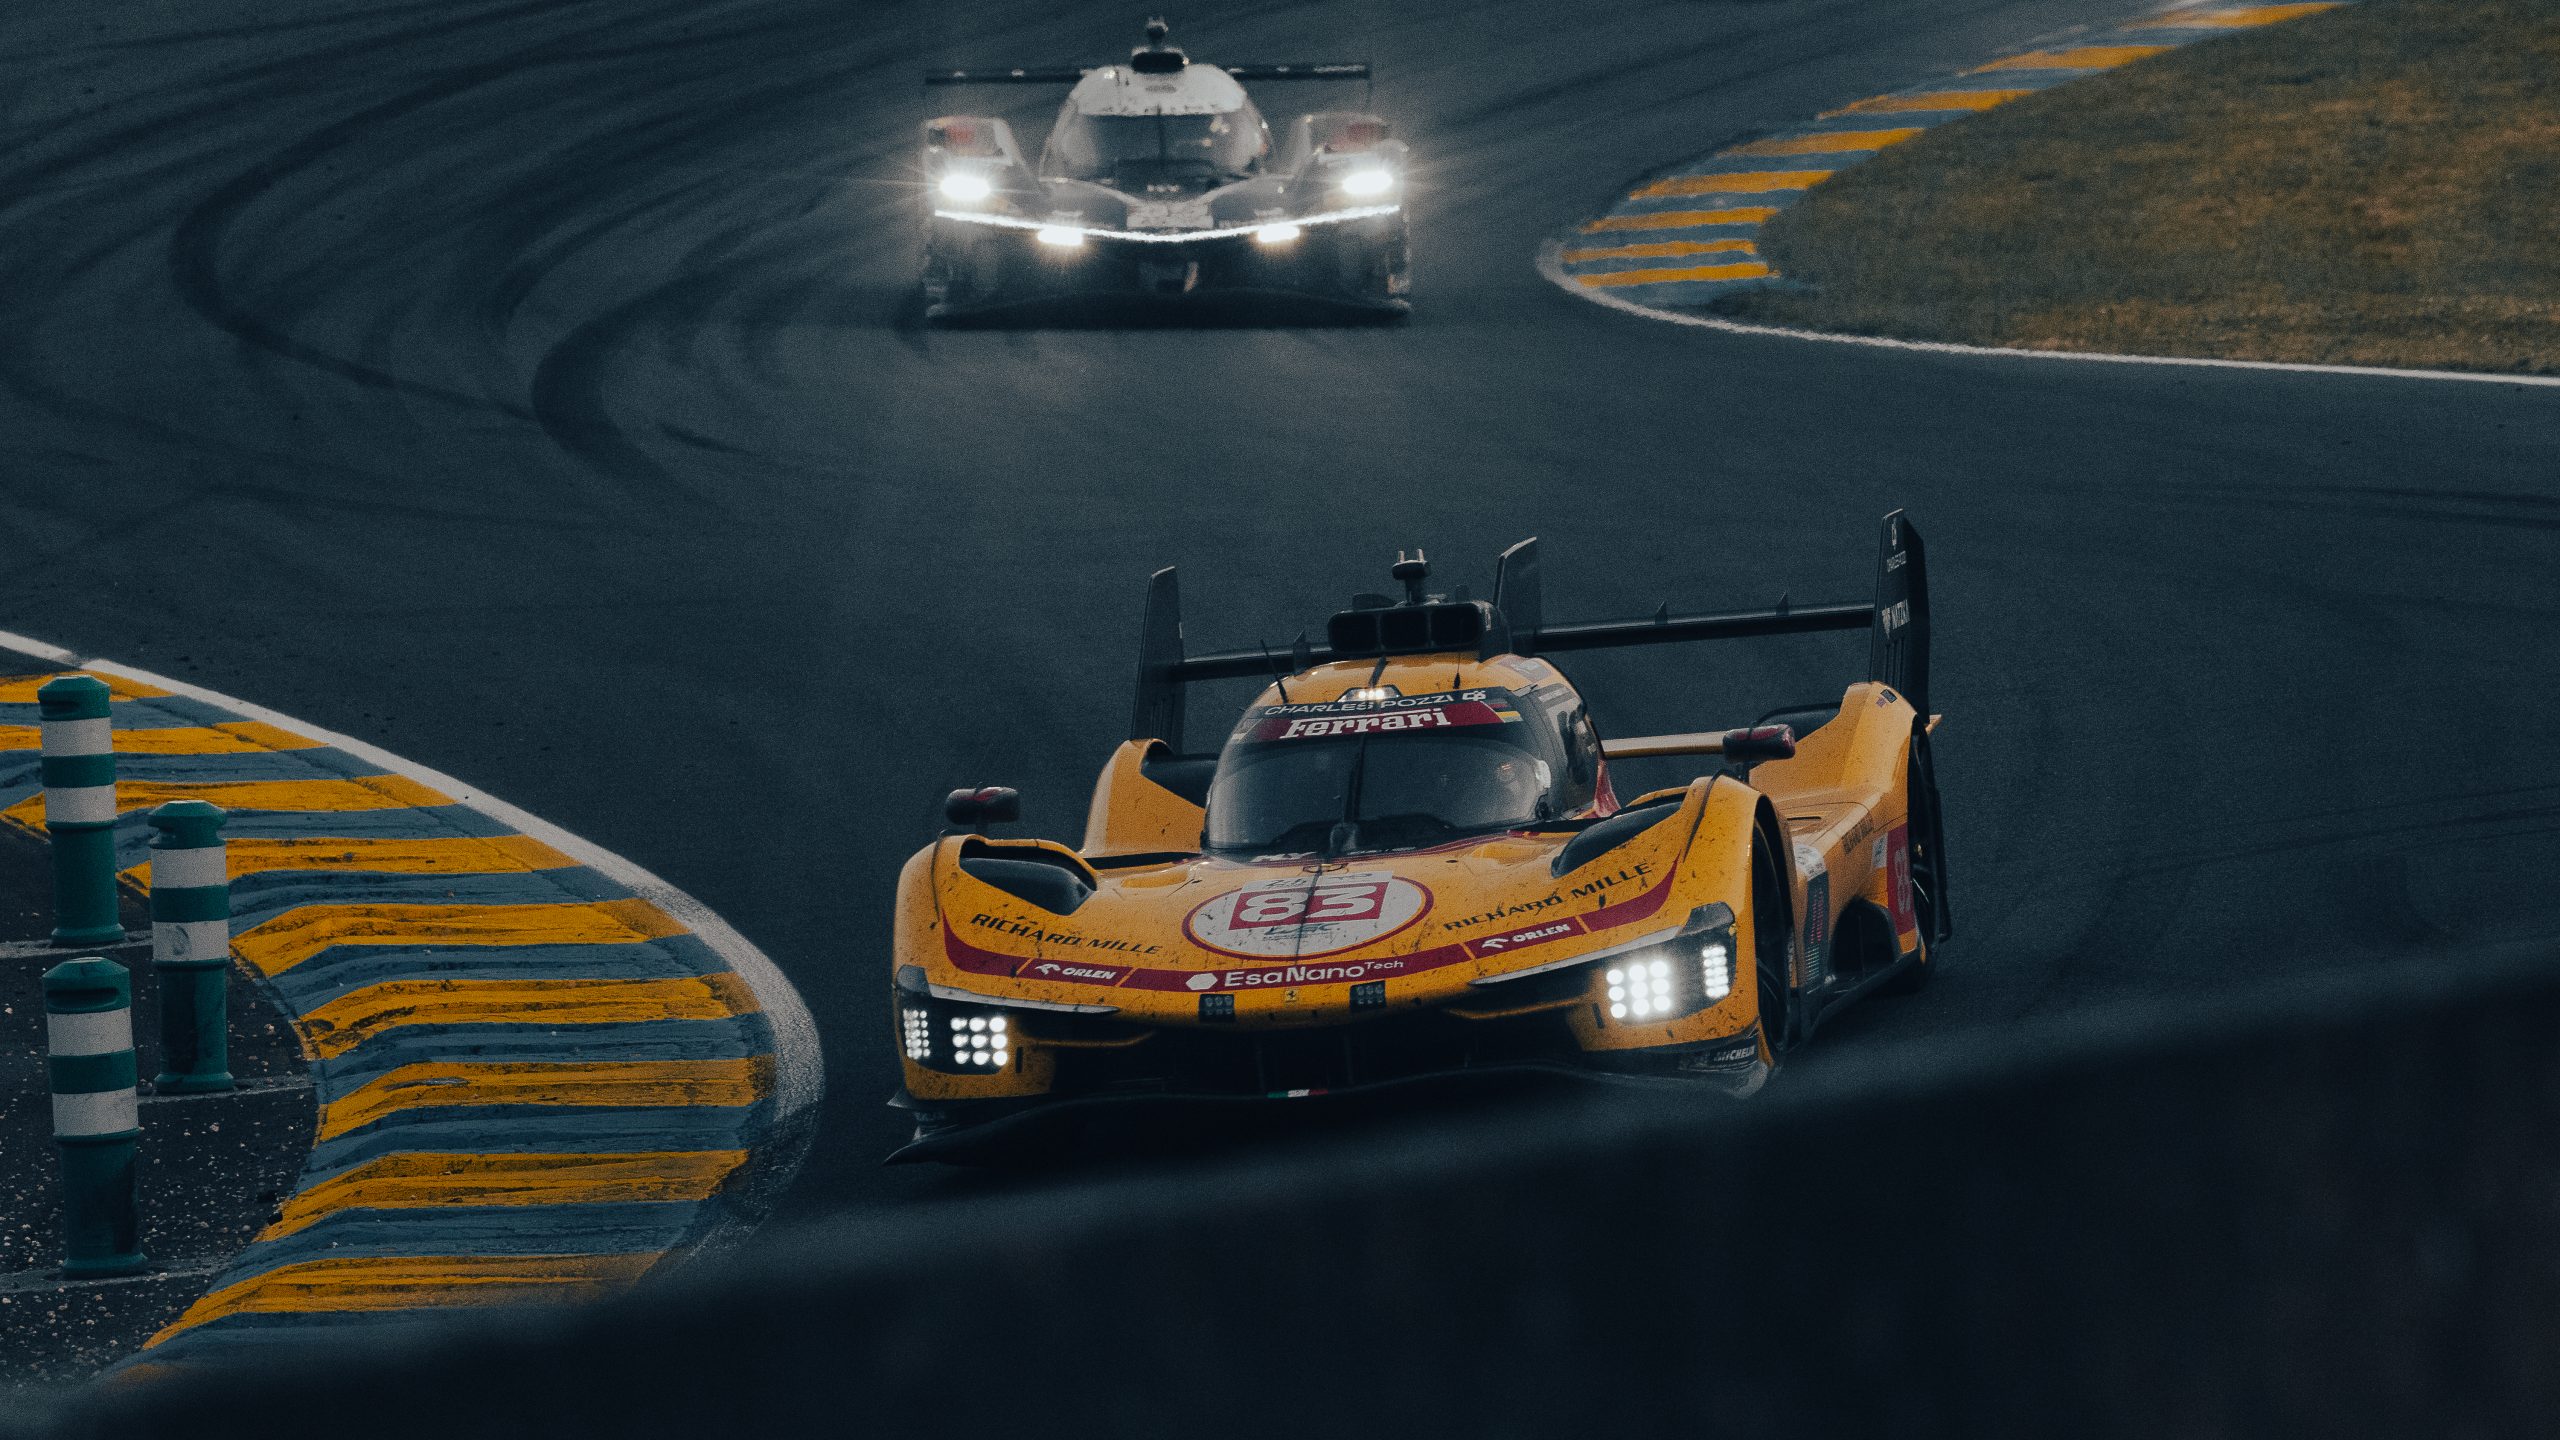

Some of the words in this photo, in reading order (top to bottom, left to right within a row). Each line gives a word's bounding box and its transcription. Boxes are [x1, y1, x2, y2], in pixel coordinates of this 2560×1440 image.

[1264, 700, 1374, 716] CHARLES
[1380, 694, 1455, 709] POZZI
[1279, 707, 1452, 740] Ferrari
[1239, 885, 1377, 922] 83
[1443, 892, 1564, 931] RICHARD
[1571, 862, 1652, 899] MILLE
[970, 912, 1083, 946] RICHARD
[1089, 937, 1163, 956] MILLE
[1512, 923, 1571, 943] ORLEN
[1062, 967, 1117, 980] ORLEN
